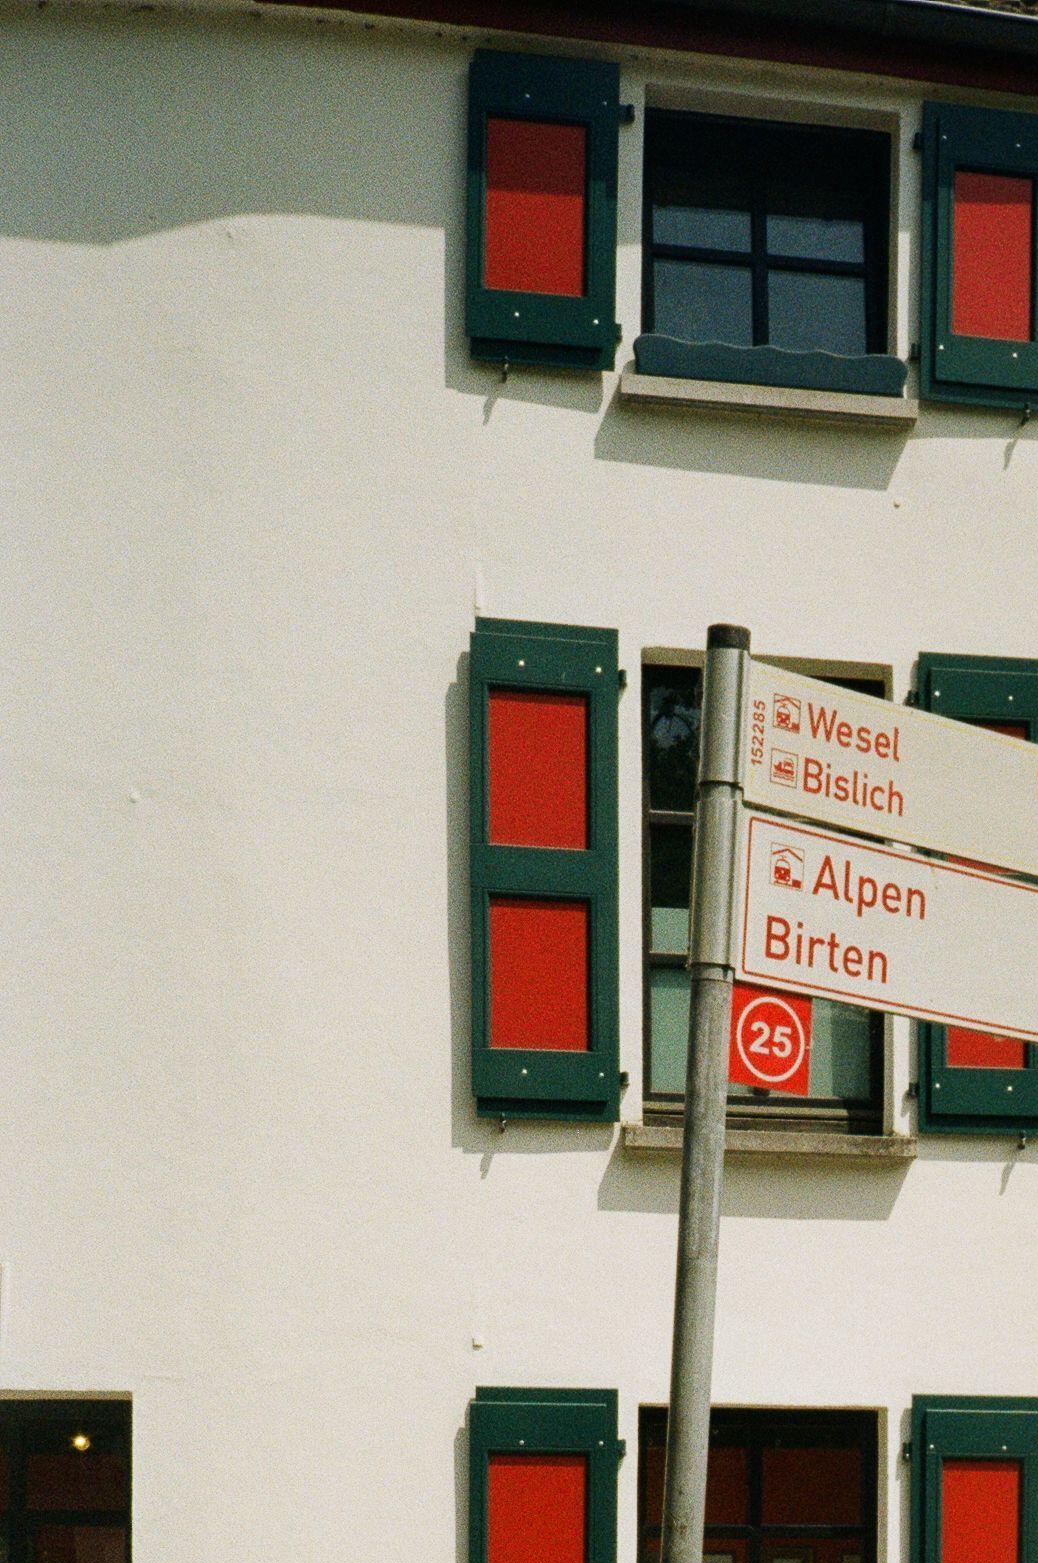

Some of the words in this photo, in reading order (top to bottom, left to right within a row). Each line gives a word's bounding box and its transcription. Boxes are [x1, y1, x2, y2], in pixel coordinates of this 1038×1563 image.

[751, 699, 766, 766] 152285
[807, 702, 900, 762] Wesel
[803, 757, 904, 817] Bislich
[812, 855, 927, 920] Alpen
[764, 915, 888, 984] Birten
[750, 1021, 793, 1058] 25
